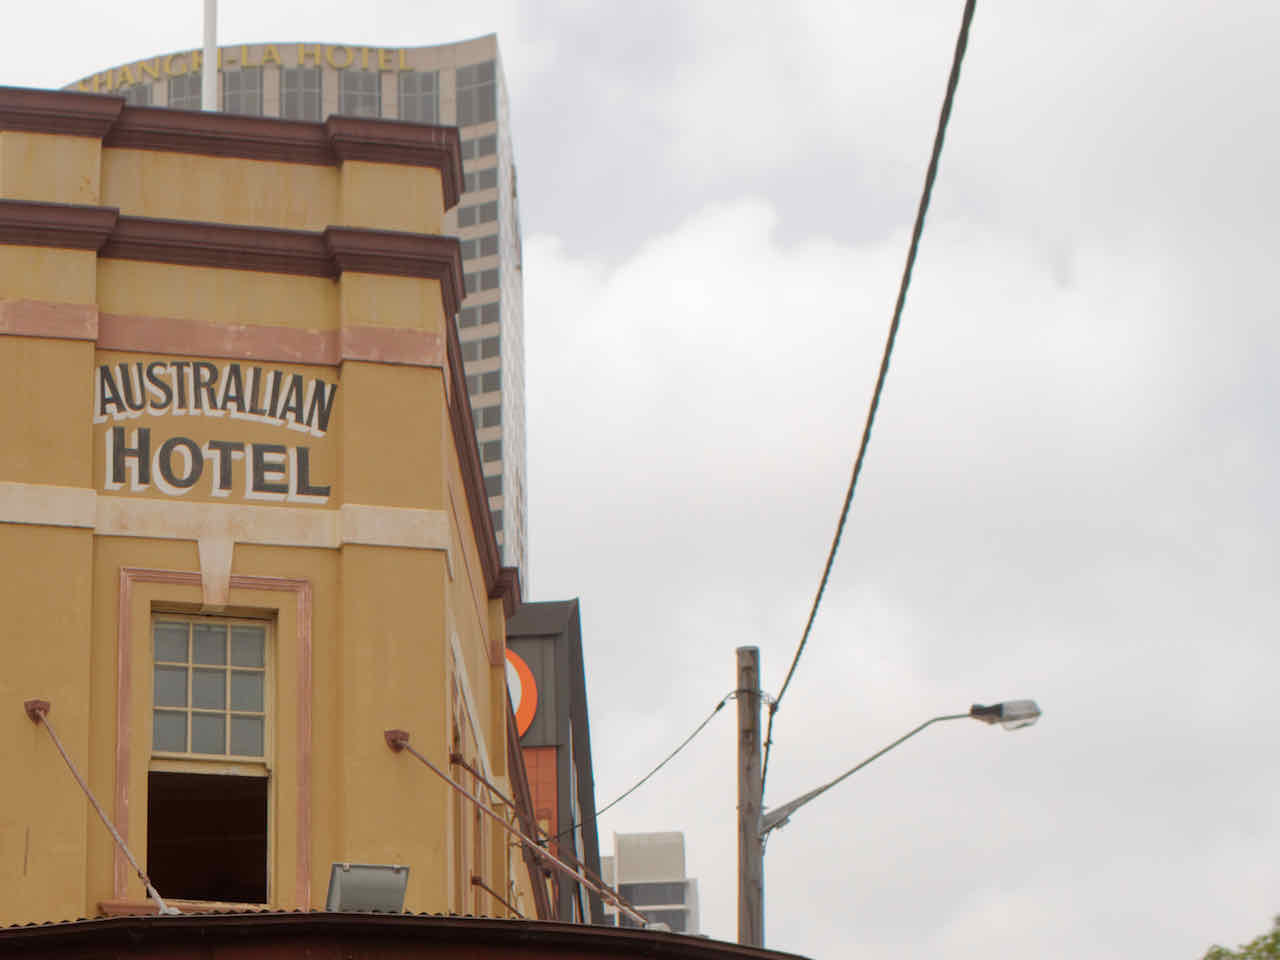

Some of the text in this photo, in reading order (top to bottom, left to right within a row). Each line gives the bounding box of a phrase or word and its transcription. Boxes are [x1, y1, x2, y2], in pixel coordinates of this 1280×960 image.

[297, 43, 415, 71] HOTEL
[95, 360, 338, 438] AUSTRALIAN
[104, 426, 331, 504] HOTEL
